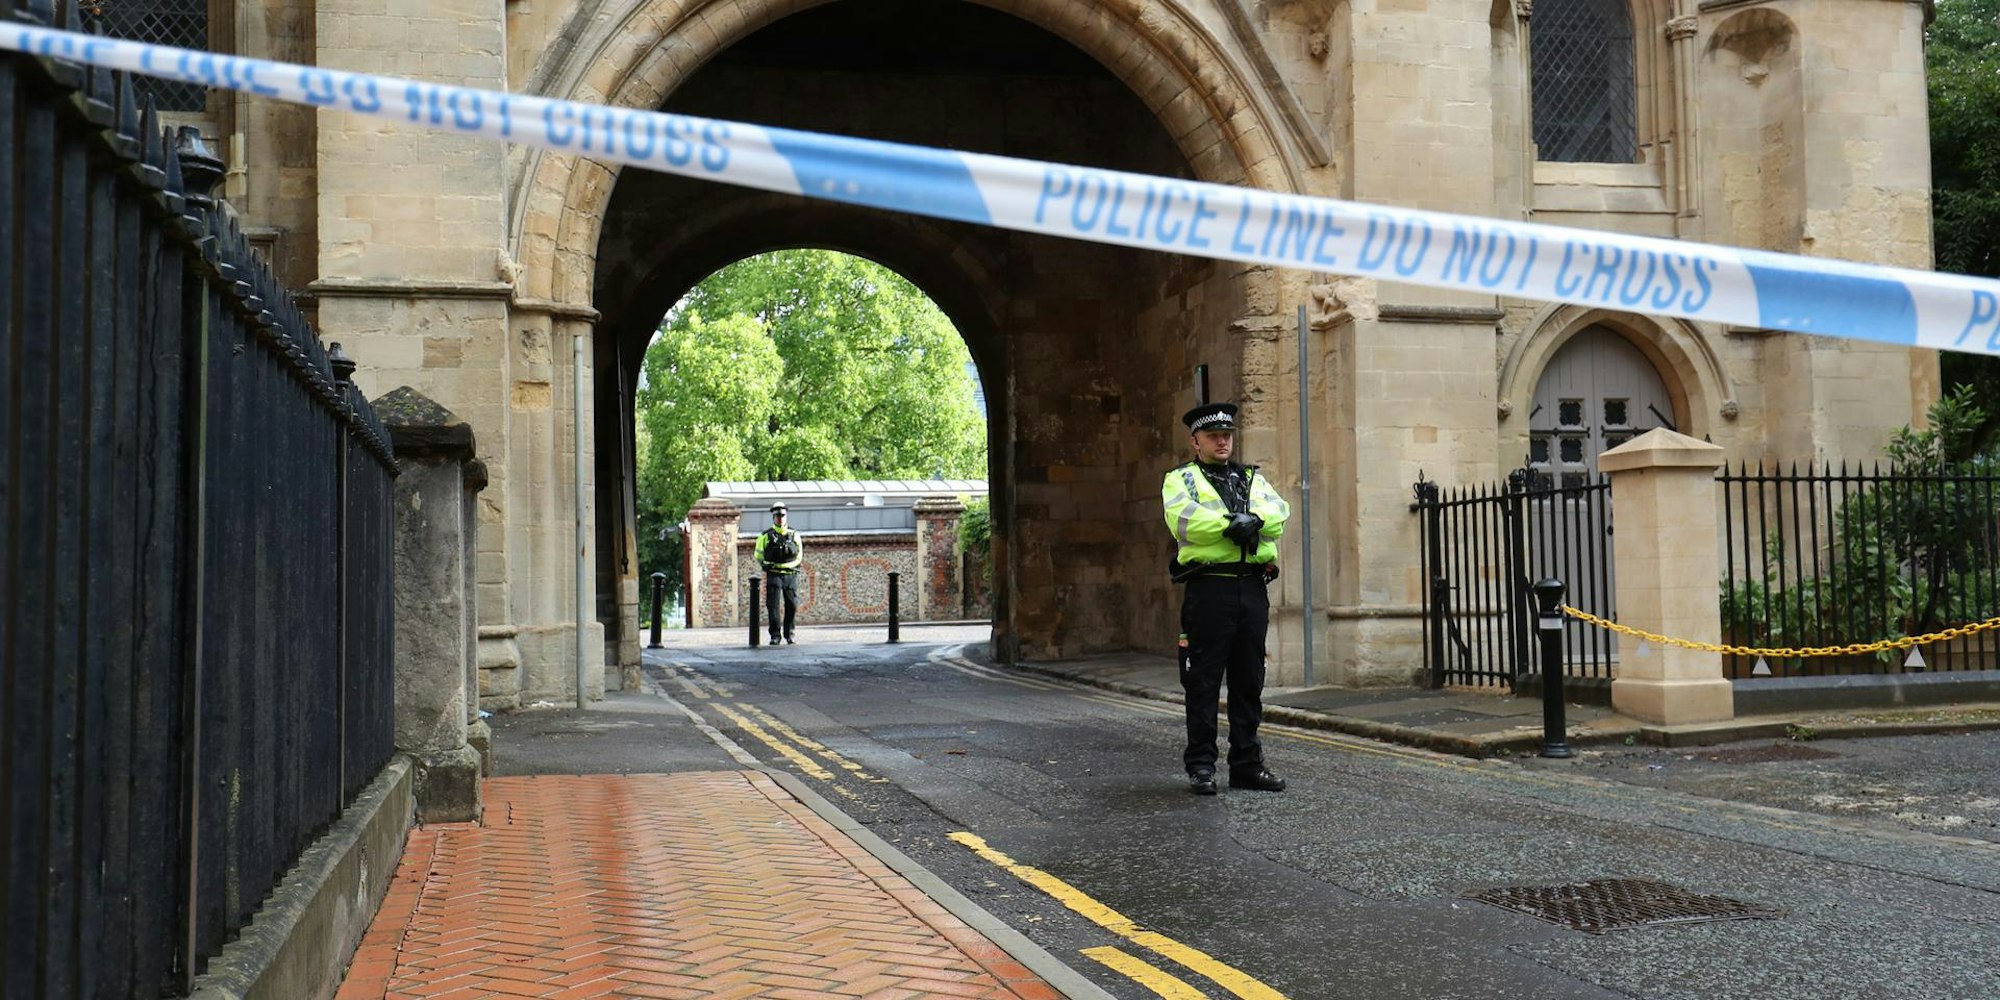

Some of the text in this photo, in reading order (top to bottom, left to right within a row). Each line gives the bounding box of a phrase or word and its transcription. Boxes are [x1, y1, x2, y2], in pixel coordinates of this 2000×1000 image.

[543, 102, 732, 173] CROSS
[1034, 167, 1718, 316] POLICE LINE DO NOT CROSS
